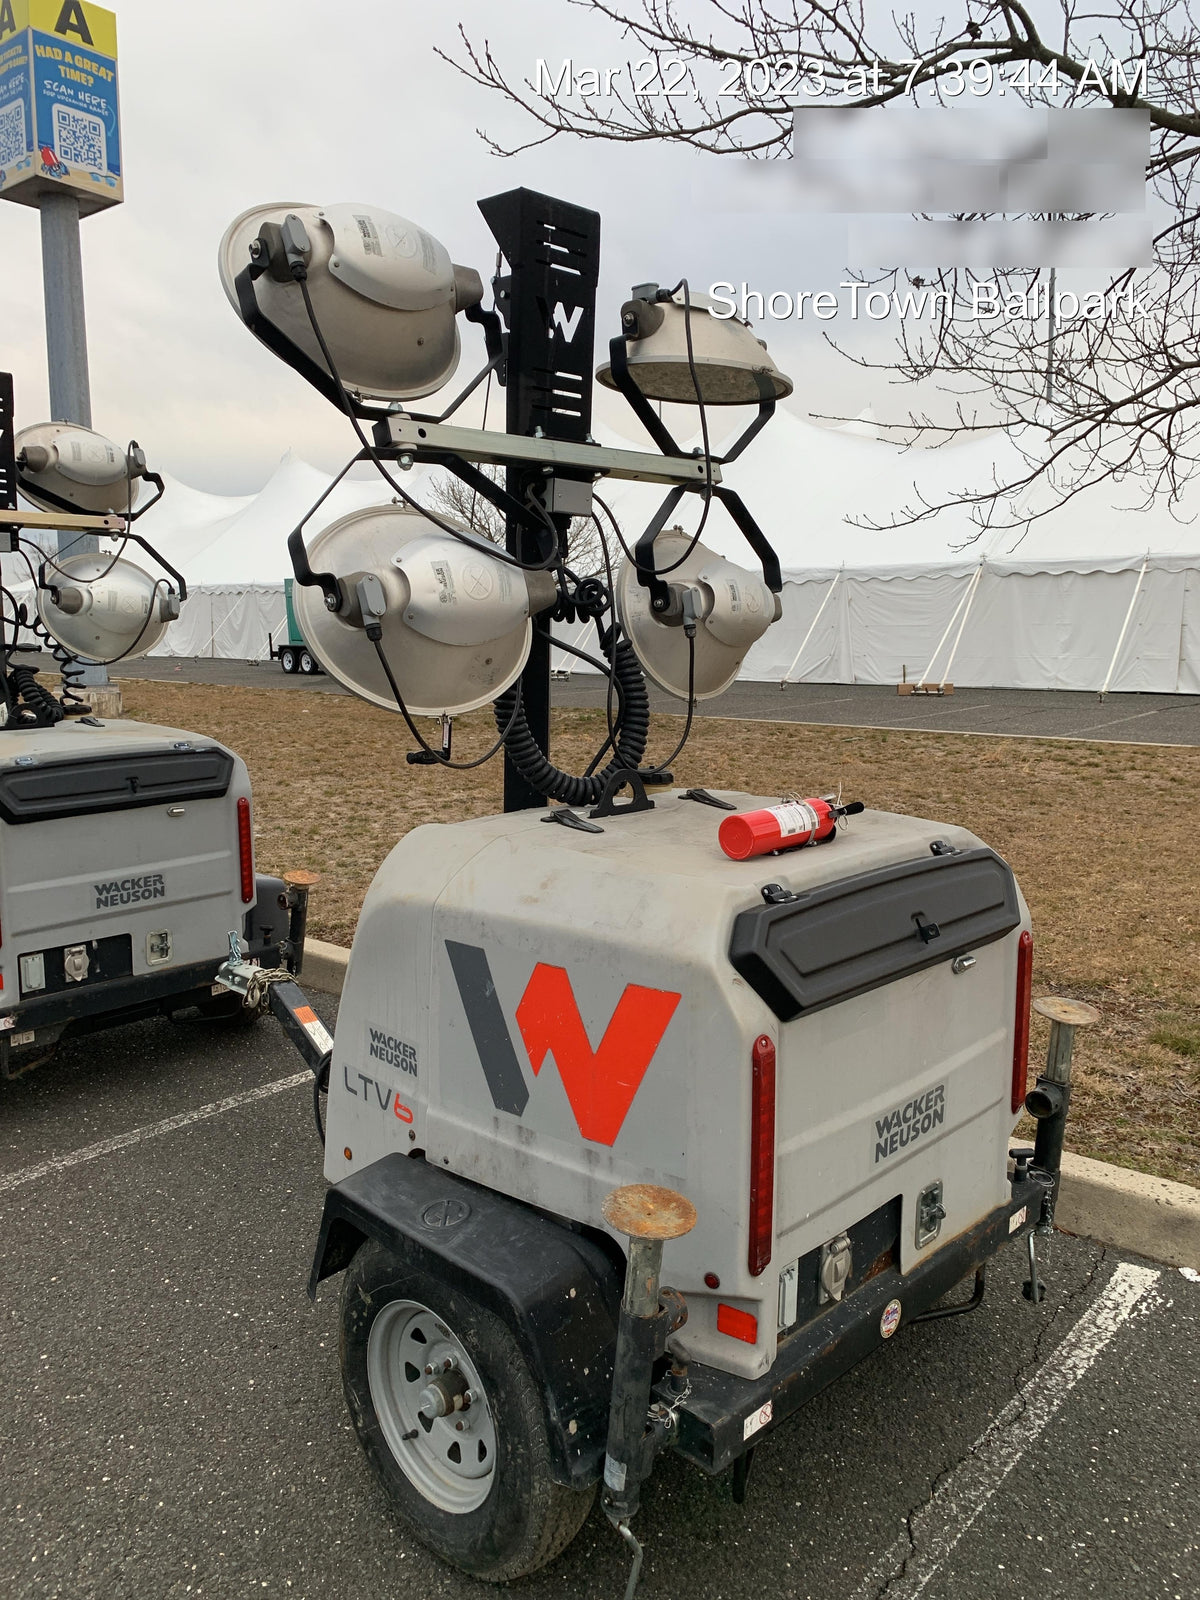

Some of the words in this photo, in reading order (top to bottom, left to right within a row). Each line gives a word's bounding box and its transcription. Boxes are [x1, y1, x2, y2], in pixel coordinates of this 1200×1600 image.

[54, 0, 95, 46] A
[35, 44, 63, 60] HAD
[64, 51, 73, 64] A
[74, 54, 114, 82] GREAT
[58, 64, 94, 87] TIME?
[43, 79, 74, 96] SCAN
[78, 91, 107, 109] HERE
[94, 873, 165, 897] WACKER
[95, 885, 166, 910] NEUSON
[368, 1027, 418, 1063] WACKER
[368, 1042, 418, 1078] NEUSON
[343, 1065, 414, 1125] LTV6
[875, 1084, 945, 1139] WACKER
[875, 1103, 945, 1164] NEUSON
